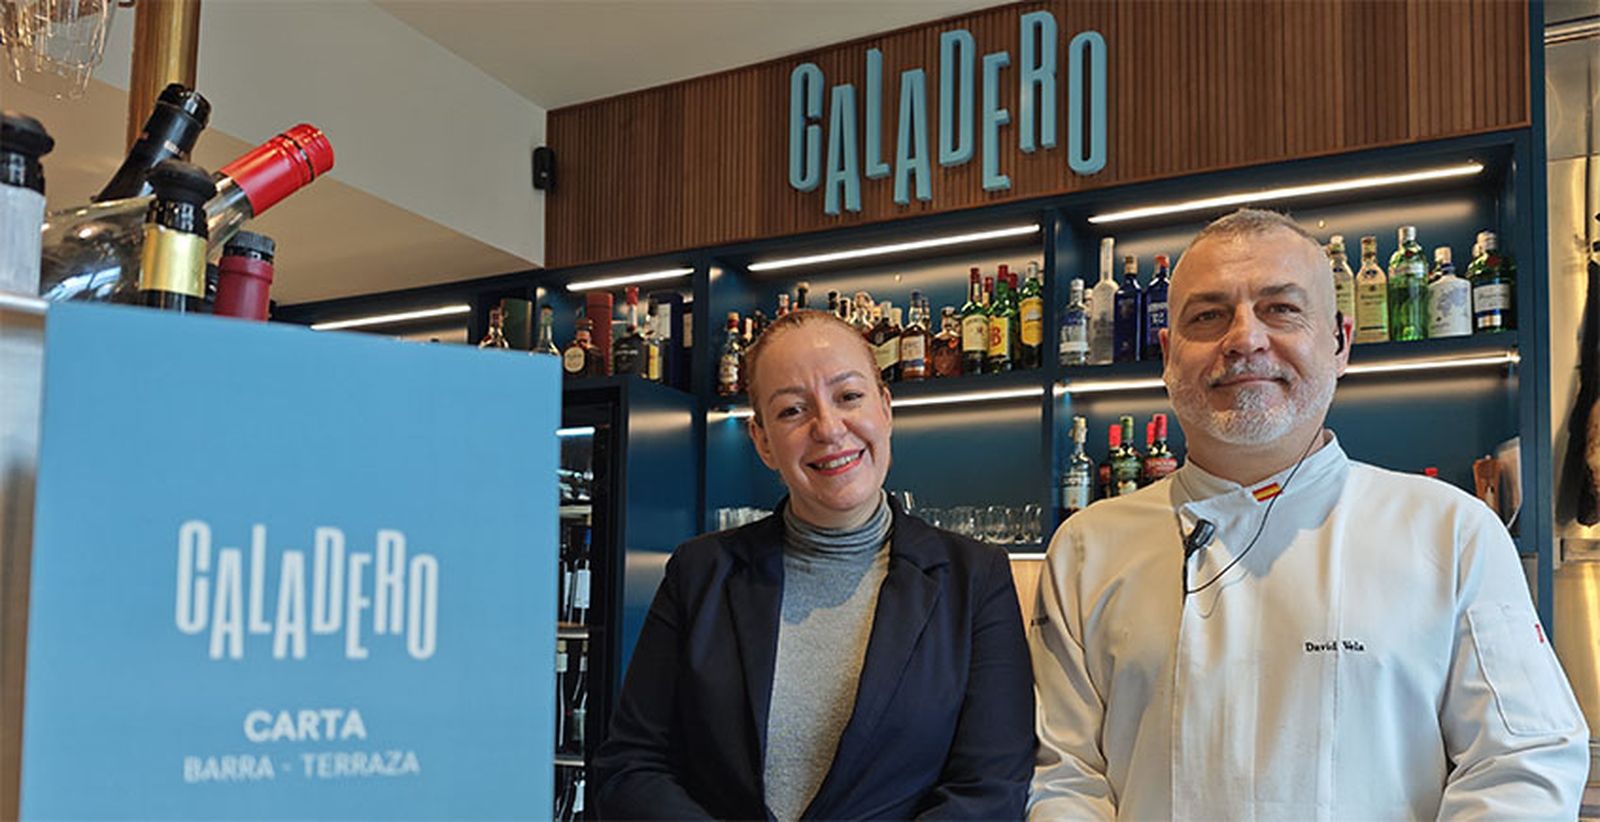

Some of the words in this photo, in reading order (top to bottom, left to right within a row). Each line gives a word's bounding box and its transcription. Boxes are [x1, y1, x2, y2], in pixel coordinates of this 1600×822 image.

[789, 10, 1107, 215] CALADERO
[175, 519, 439, 660] CALADERO
[1304, 640, 1338, 652] David
[243, 708, 367, 742] CARTA
[183, 754, 275, 783] BARRA
[302, 750, 420, 778] TERRAZA
